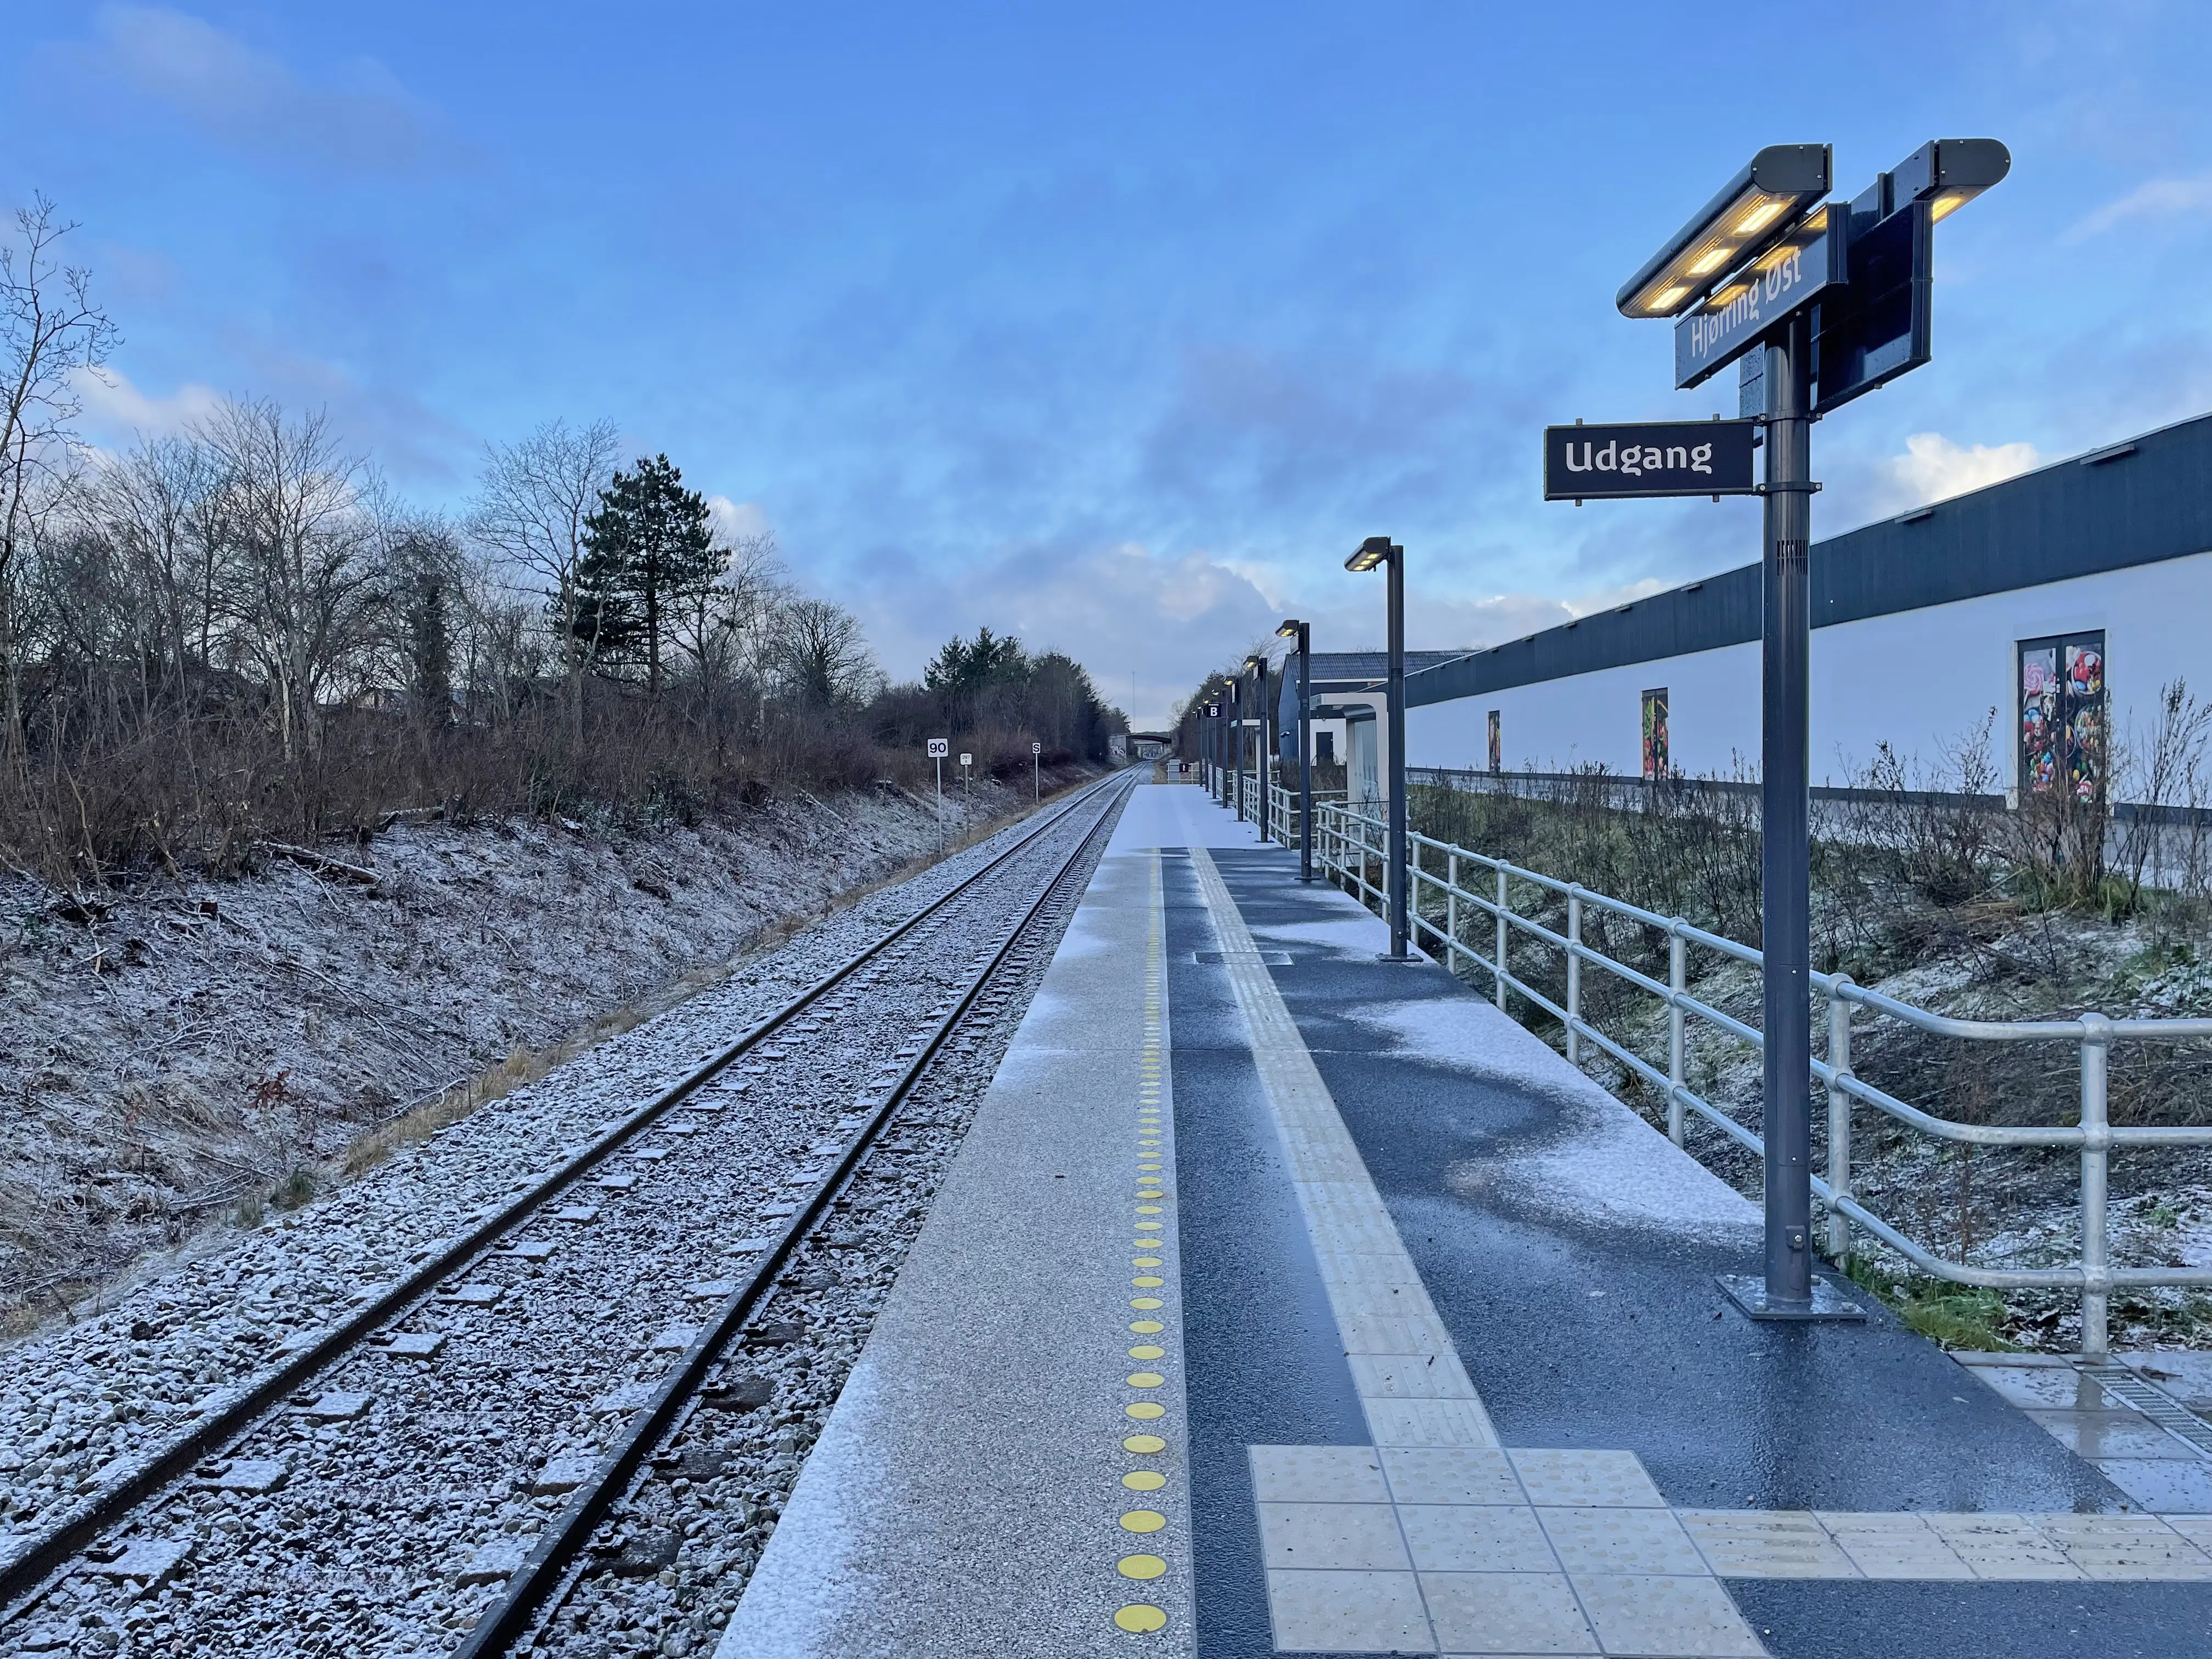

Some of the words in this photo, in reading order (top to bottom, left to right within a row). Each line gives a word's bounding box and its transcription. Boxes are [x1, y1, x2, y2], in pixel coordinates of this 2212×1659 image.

[1692, 278, 1759, 359] Hjørring
[1765, 246, 1802, 305] Øst
[1566, 440, 1712, 476] Udgang
[1210, 707, 1218, 716] B
[929, 742, 946, 753] 90
[1033, 744, 1040, 752] S
